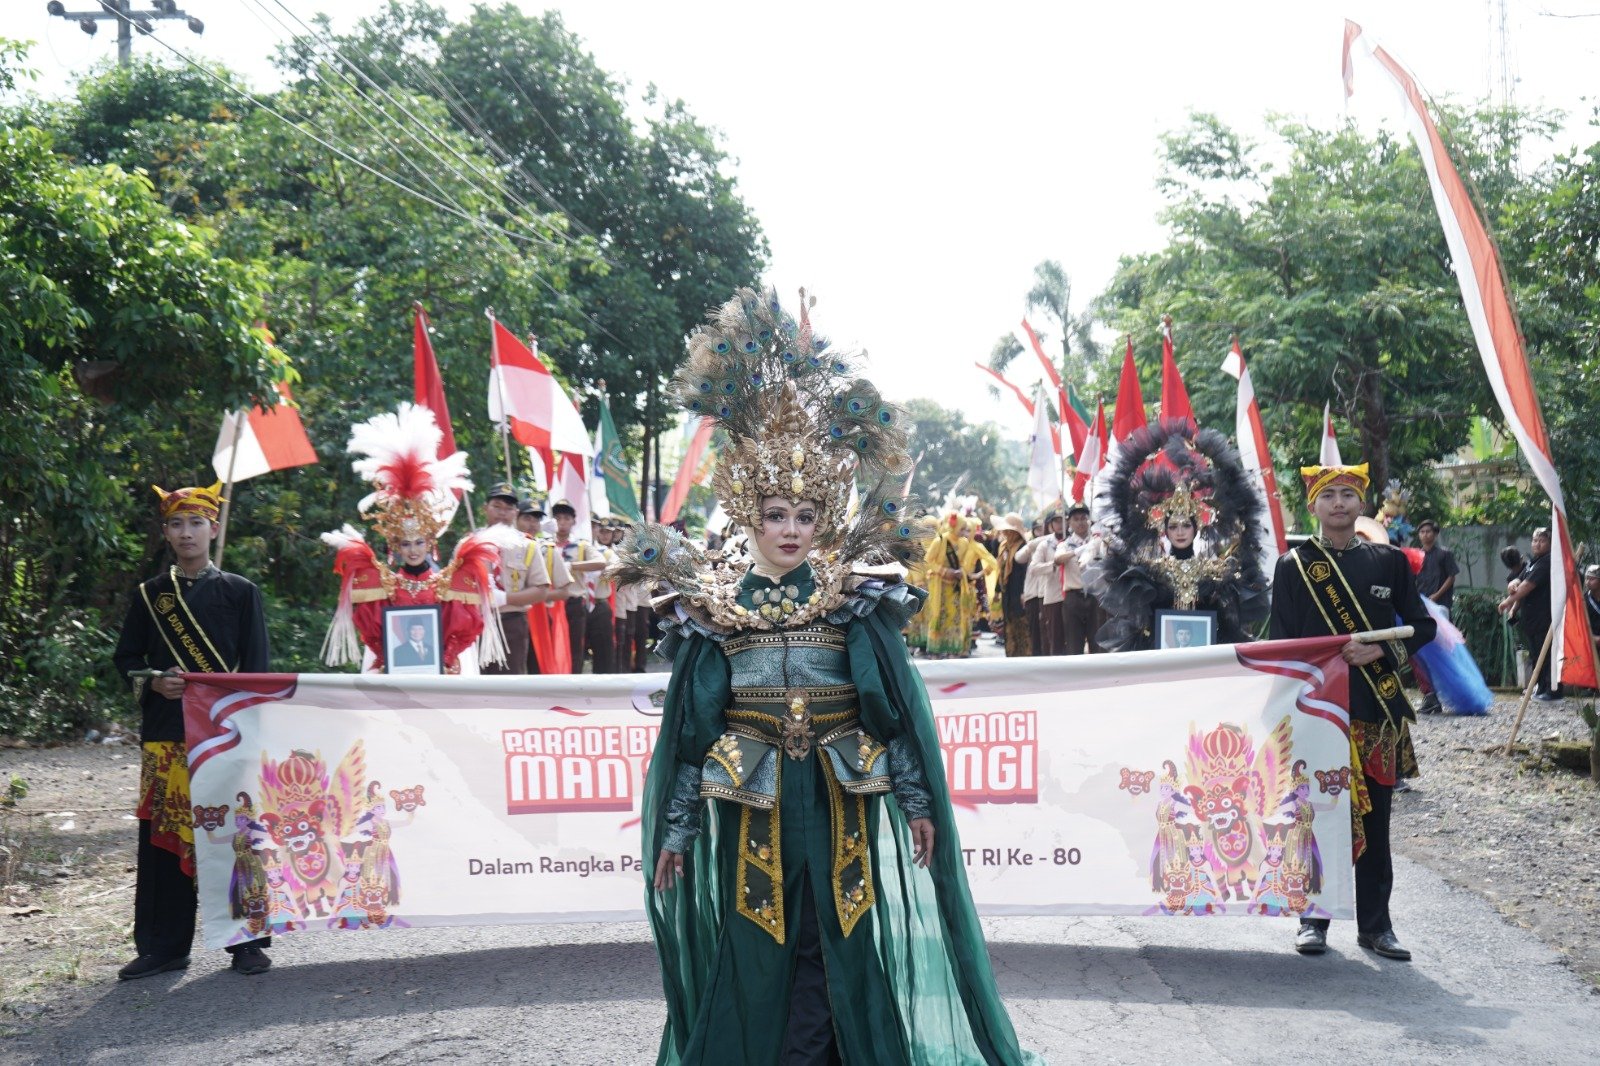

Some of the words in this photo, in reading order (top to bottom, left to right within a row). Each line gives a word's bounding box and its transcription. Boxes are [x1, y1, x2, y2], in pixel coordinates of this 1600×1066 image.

[1325, 583, 1341, 608] WAKIL
[1340, 612, 1355, 631] DUTA
[168, 613, 184, 635] DUTA
[180, 633, 215, 673] KEAGAMAA
[502, 726, 622, 756] PARADE
[936, 711, 1037, 744] WANGI
[507, 755, 631, 804] MAN
[941, 744, 1036, 794] NGI
[469, 858, 533, 876] Dalam
[539, 856, 614, 878] Rangka
[982, 848, 1000, 866] RI
[1007, 848, 1033, 866] Ke
[1053, 847, 1081, 866] 80
